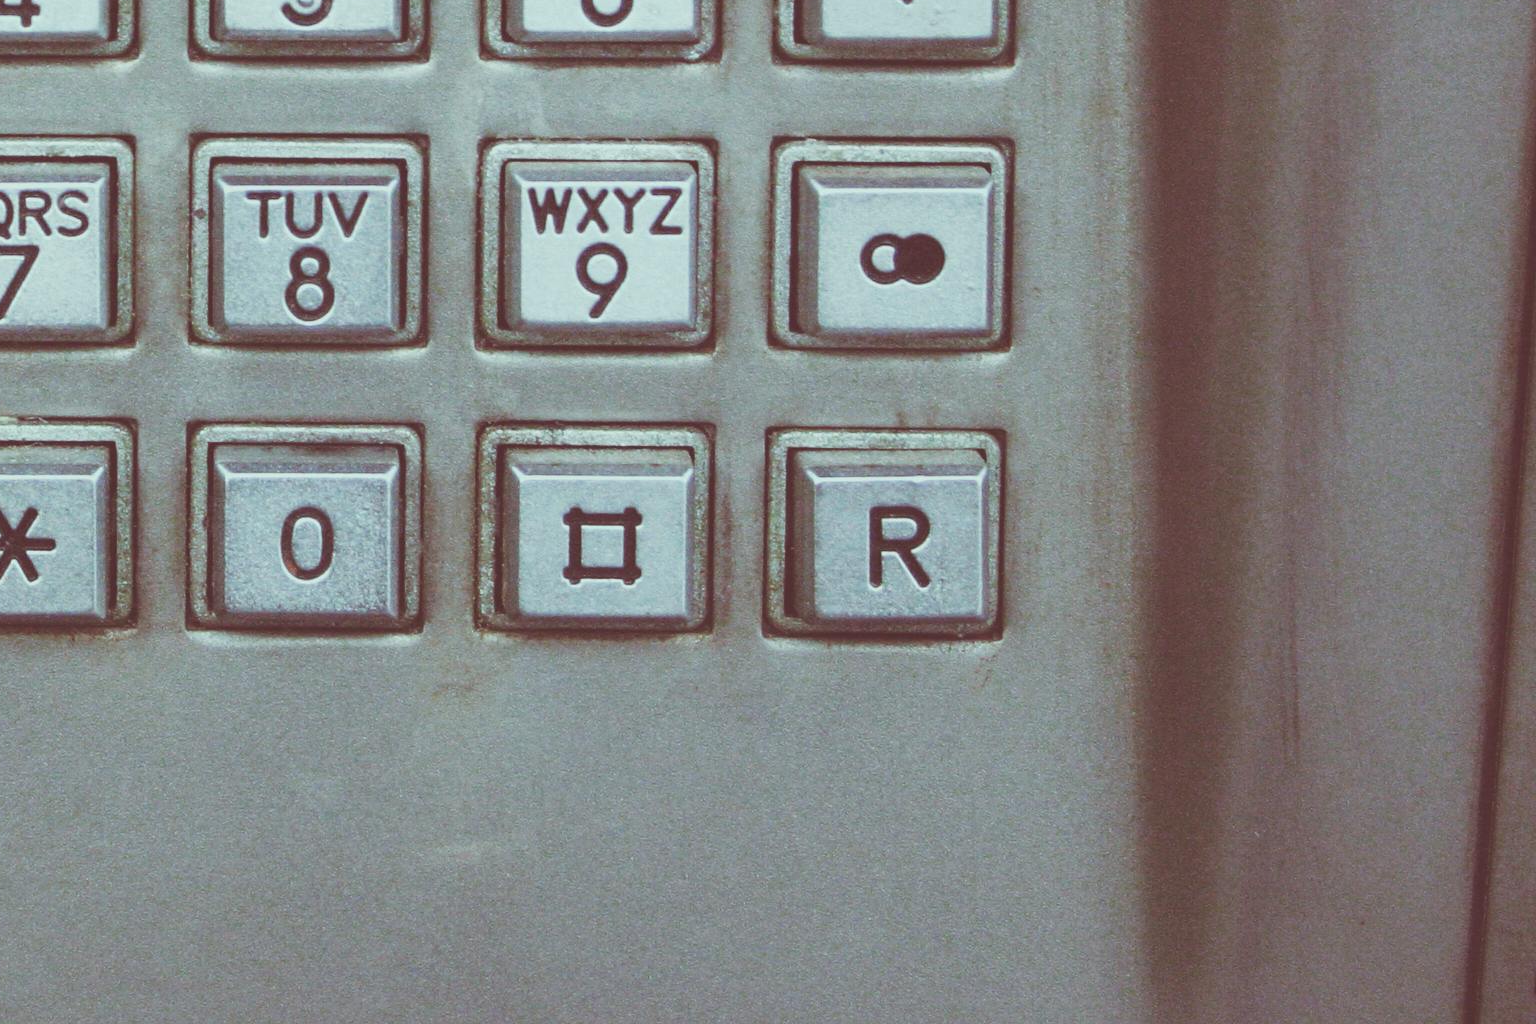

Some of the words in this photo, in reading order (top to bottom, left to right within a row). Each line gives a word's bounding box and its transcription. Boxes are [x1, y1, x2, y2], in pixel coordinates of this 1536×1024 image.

[246, 191, 369, 238] TUV
[527, 186, 684, 235] WXYZ
[285, 246, 333, 321] 8
[576, 244, 628, 318] 9
[281, 506, 336, 580] 0
[870, 503, 931, 587] R
